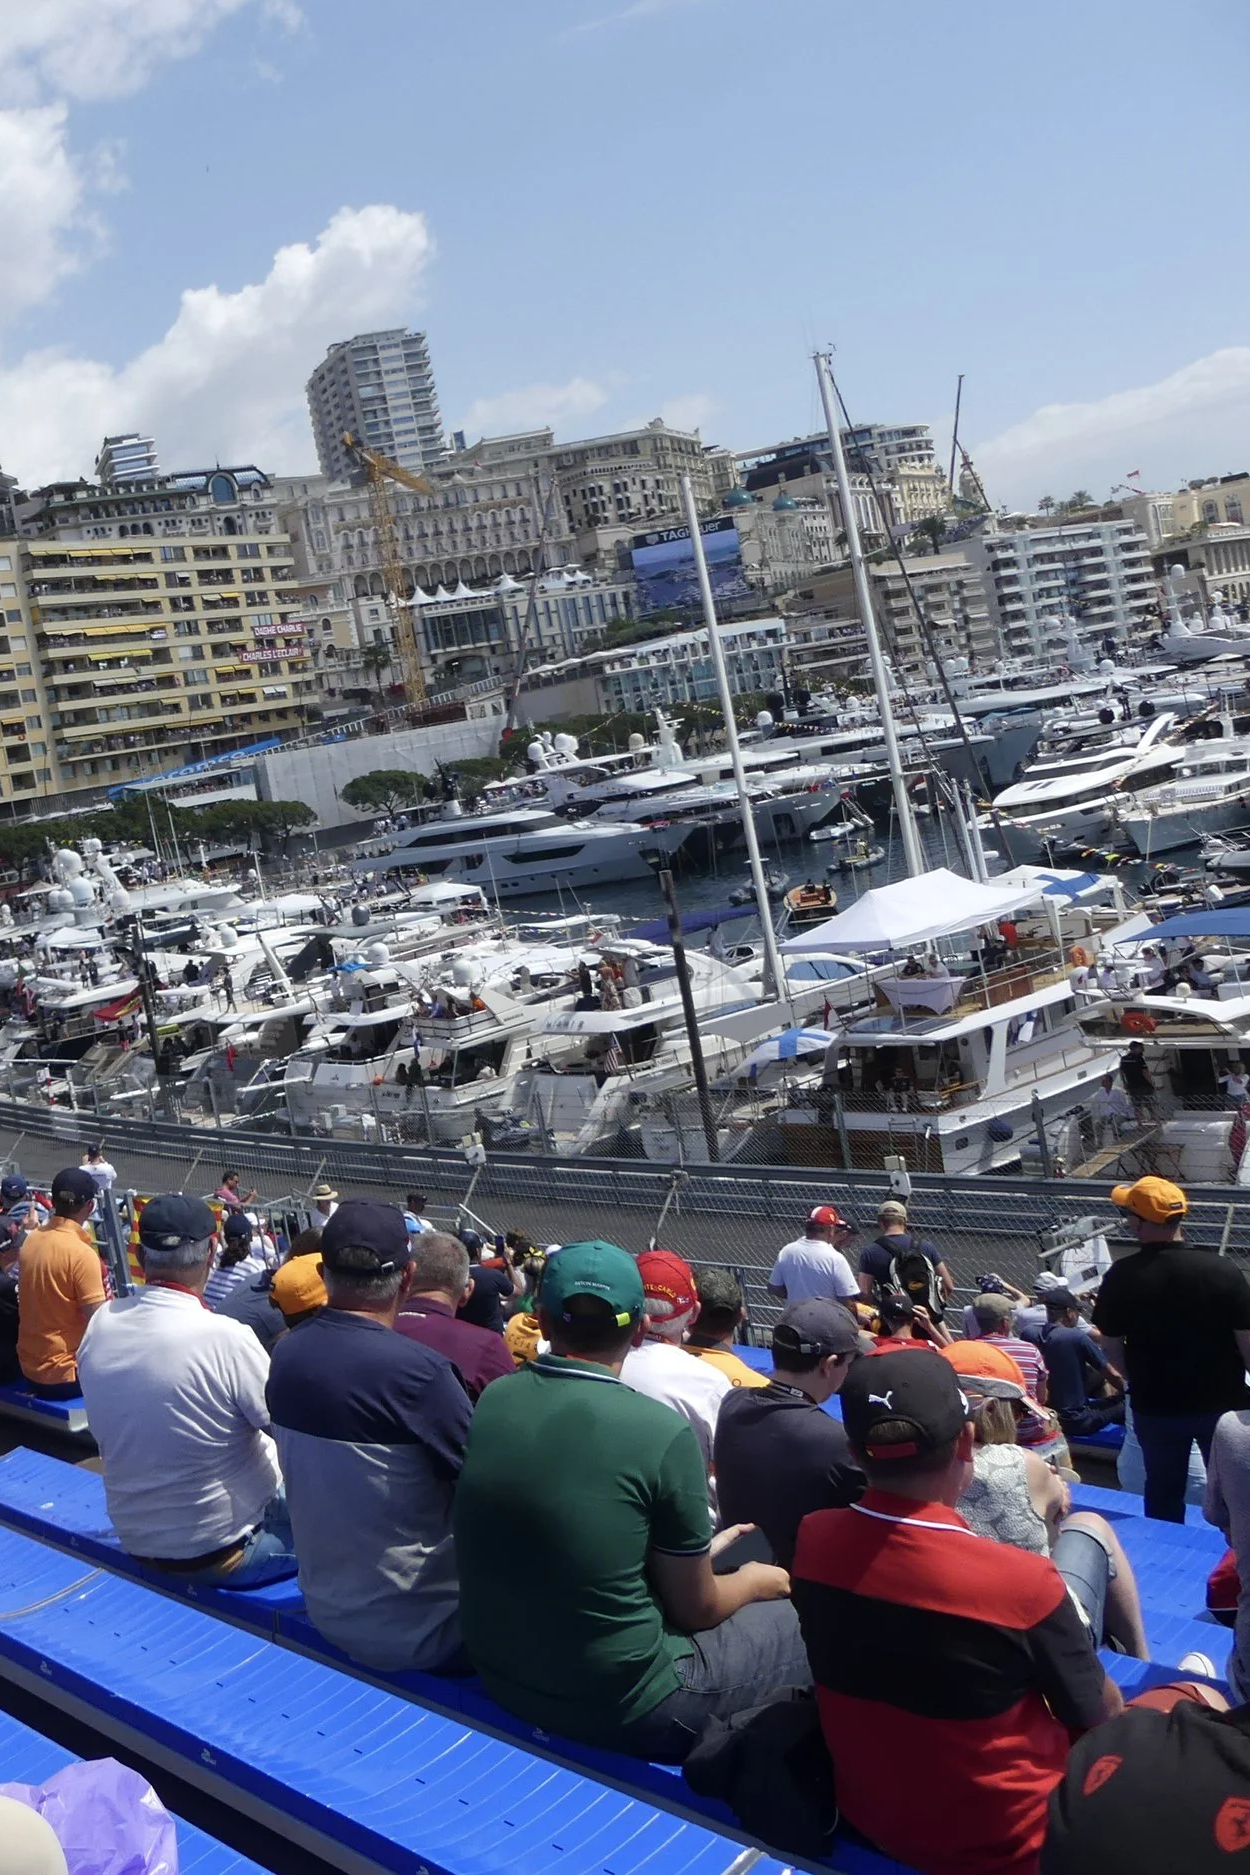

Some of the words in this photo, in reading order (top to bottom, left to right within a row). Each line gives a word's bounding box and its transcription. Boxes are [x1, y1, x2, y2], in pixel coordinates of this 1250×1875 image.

[277, 624, 302, 634] CHARLIE
[243, 650, 271, 662] CHARLES
[272, 648, 299, 659] L'ECLAIR
